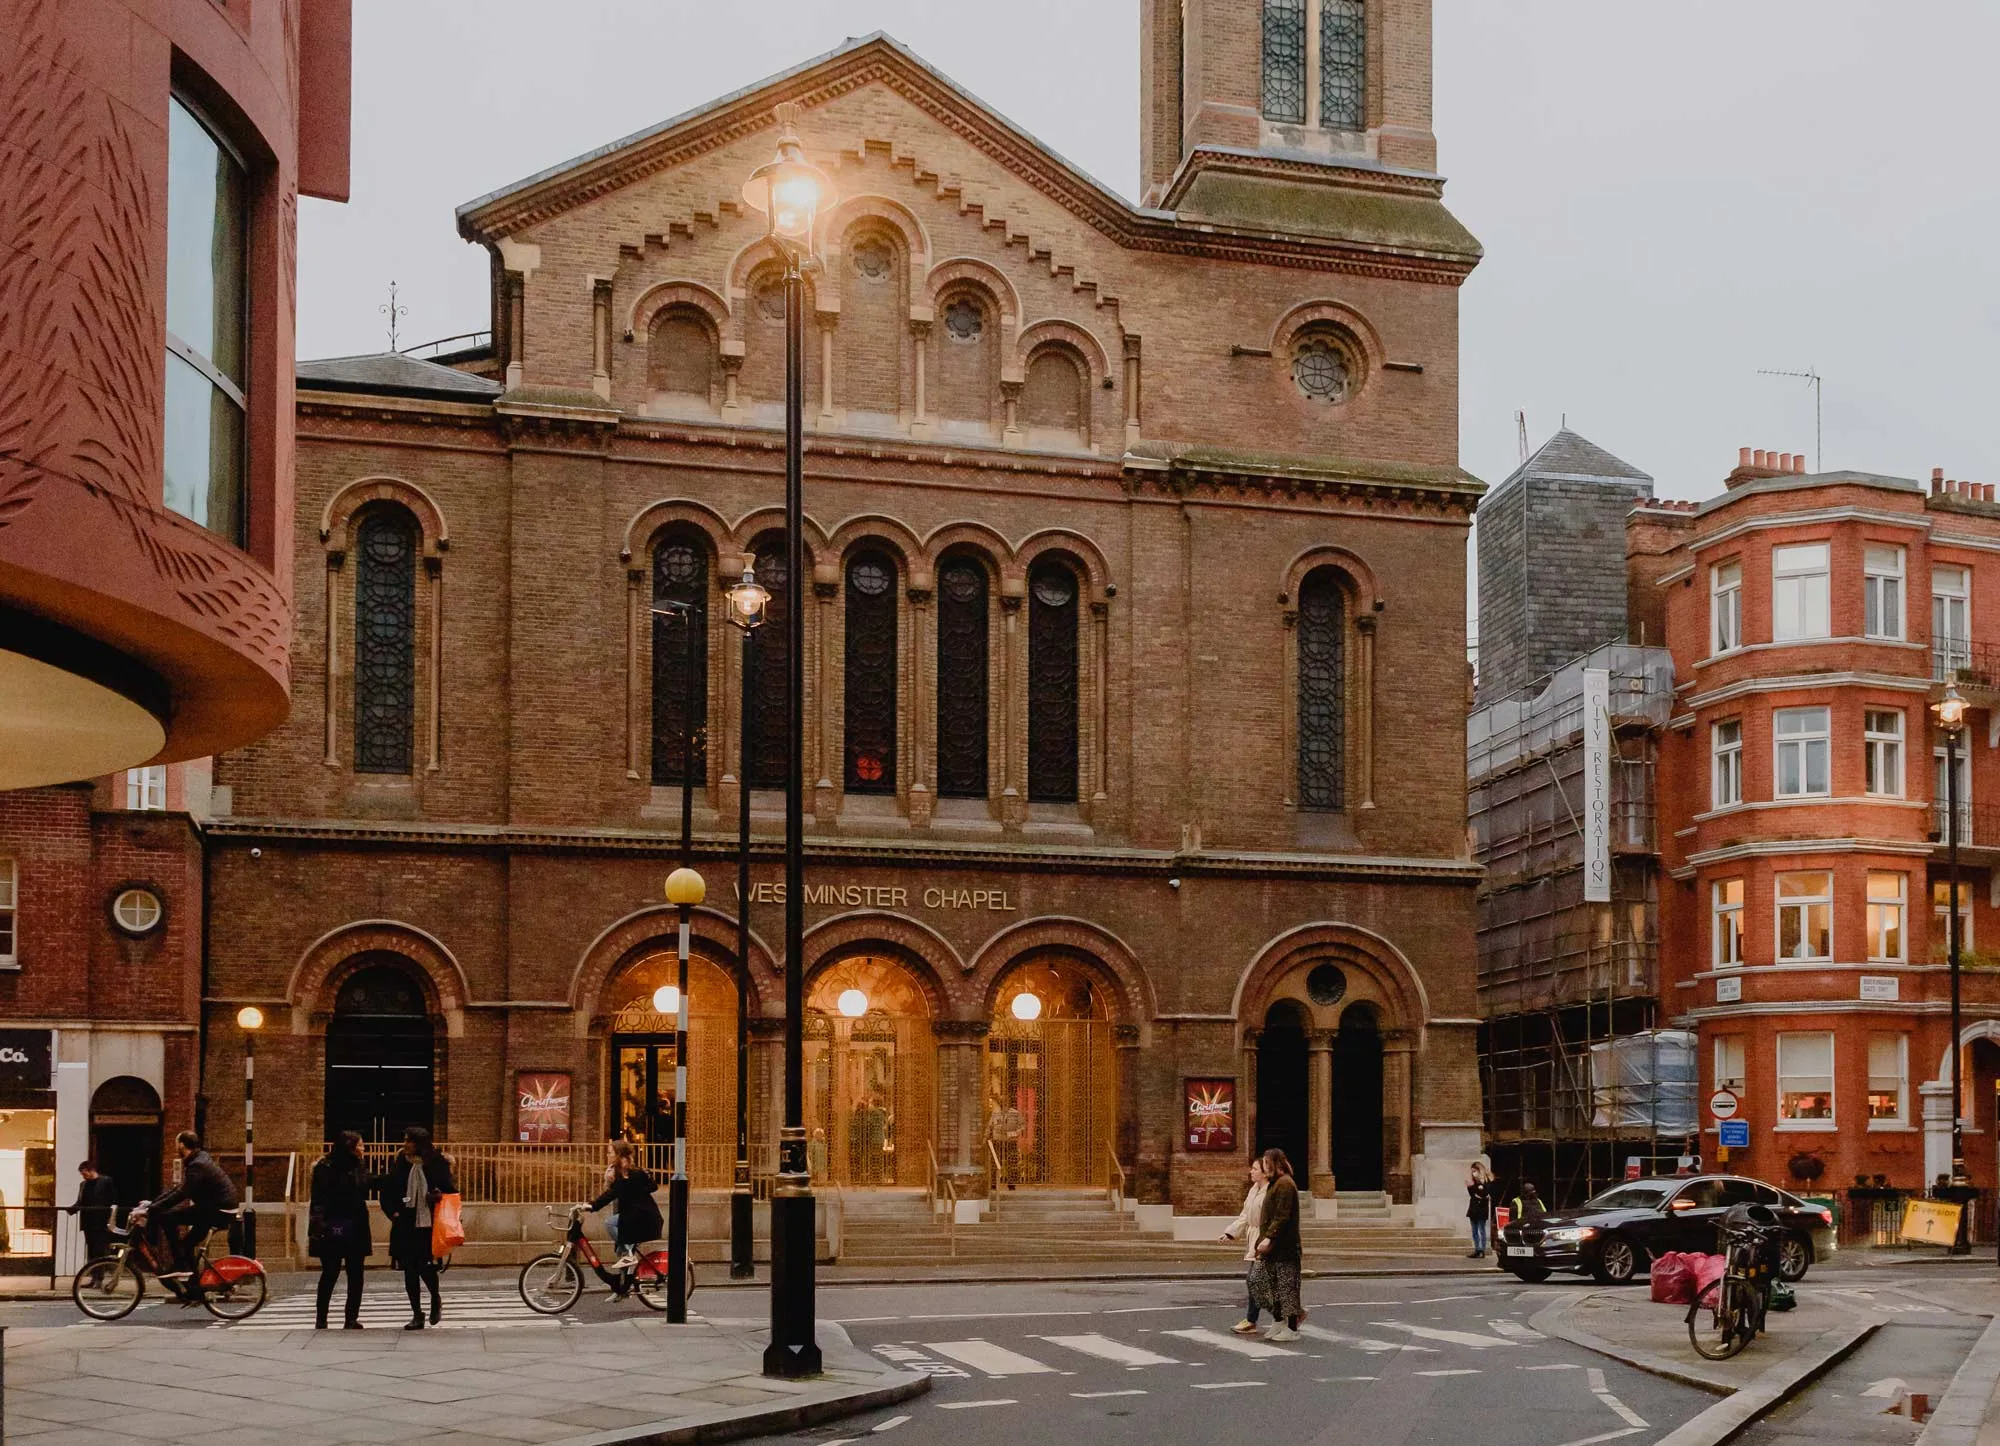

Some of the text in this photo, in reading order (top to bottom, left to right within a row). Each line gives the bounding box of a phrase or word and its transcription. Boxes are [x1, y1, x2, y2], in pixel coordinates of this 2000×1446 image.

[1592, 694, 1602, 741] CITY
[1591, 751, 1604, 883] RESTORATION
[732, 882, 1017, 911] WESMINSTER CHAPEL
[1911, 1203, 1957, 1217] Diversion
